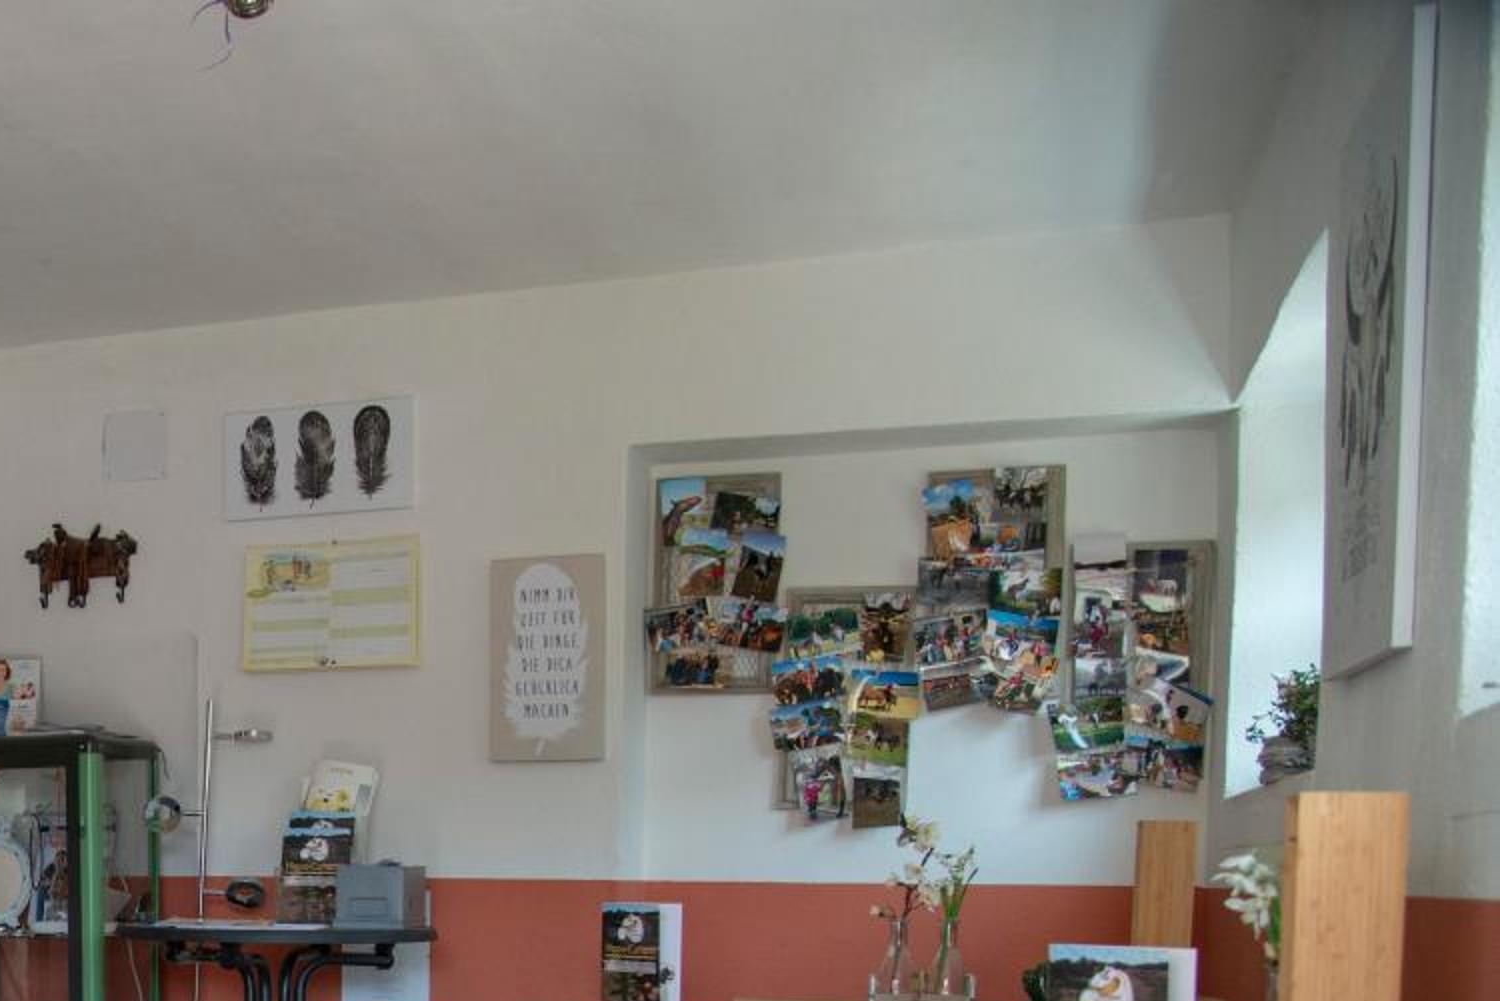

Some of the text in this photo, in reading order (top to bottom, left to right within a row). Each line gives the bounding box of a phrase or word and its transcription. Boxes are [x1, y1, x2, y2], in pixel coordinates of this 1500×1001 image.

[520, 586, 575, 604] NIMM DIR
[520, 611, 547, 627] ZEIT
[517, 634, 535, 650] DIE
[521, 656, 573, 673] DIE DICH
[523, 703, 570, 720] MACHEN
